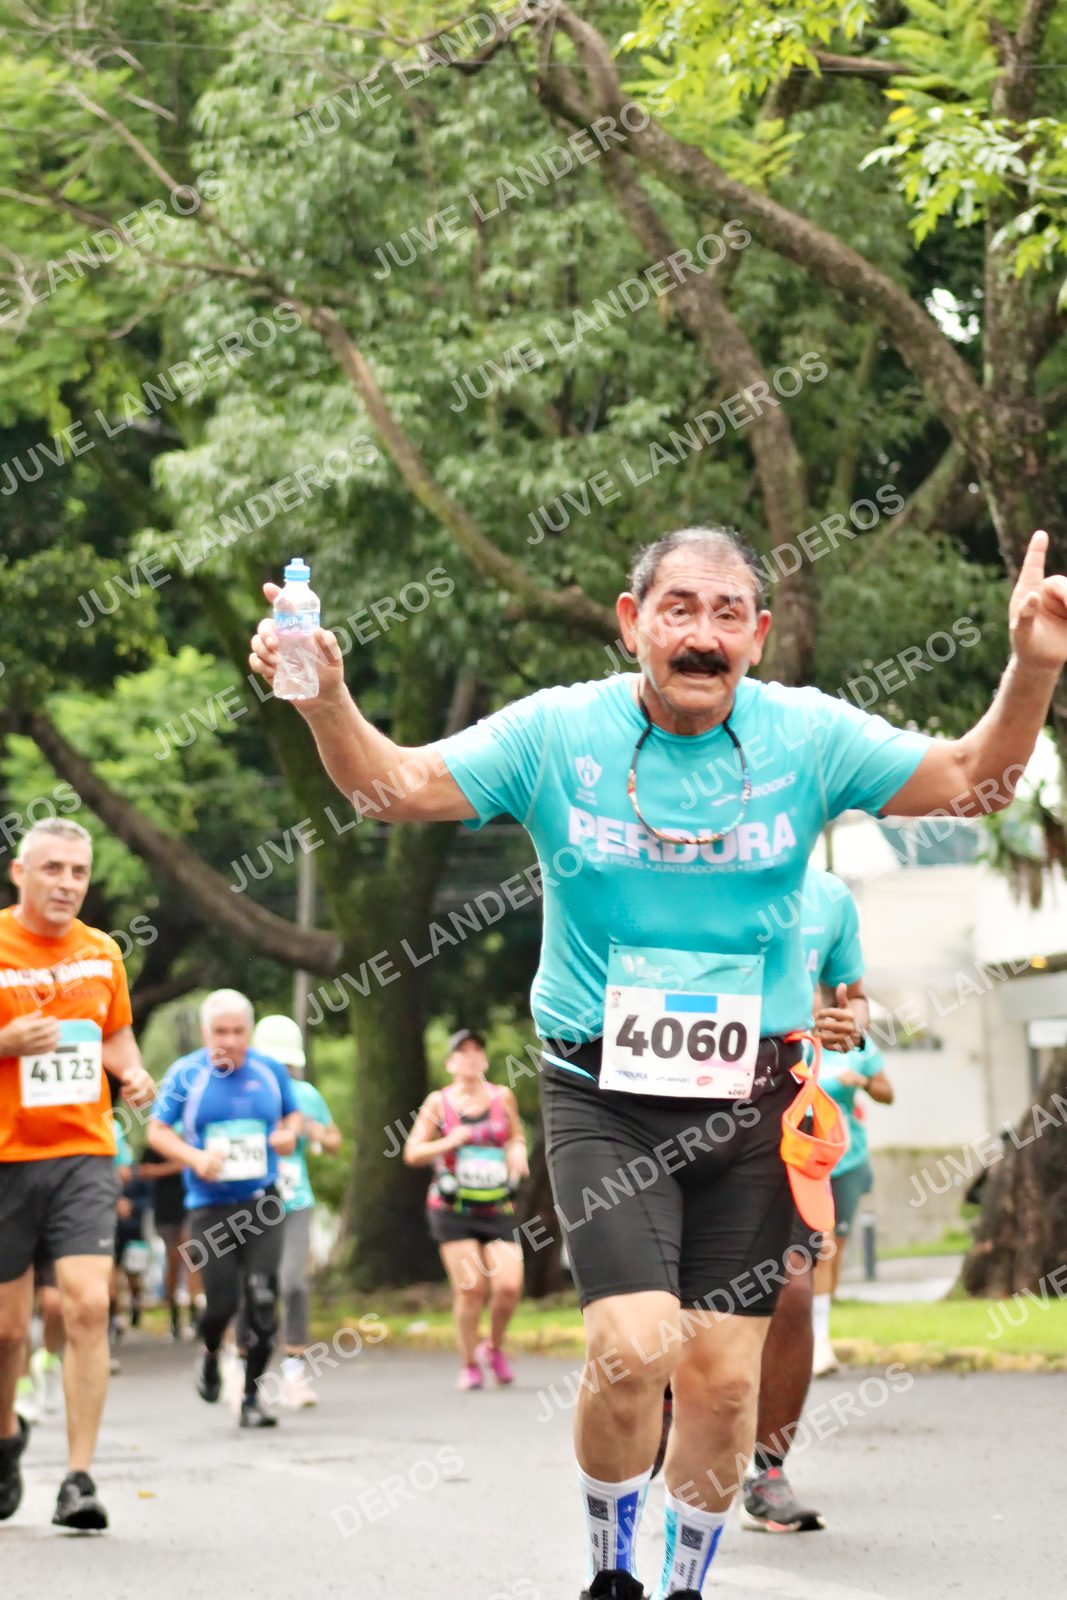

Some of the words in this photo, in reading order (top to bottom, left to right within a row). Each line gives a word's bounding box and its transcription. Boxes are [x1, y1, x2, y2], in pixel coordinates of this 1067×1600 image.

[569, 805, 797, 864] PERDURA
[616, 1014, 747, 1062] 4060
[31, 1058, 95, 1082] 4123
